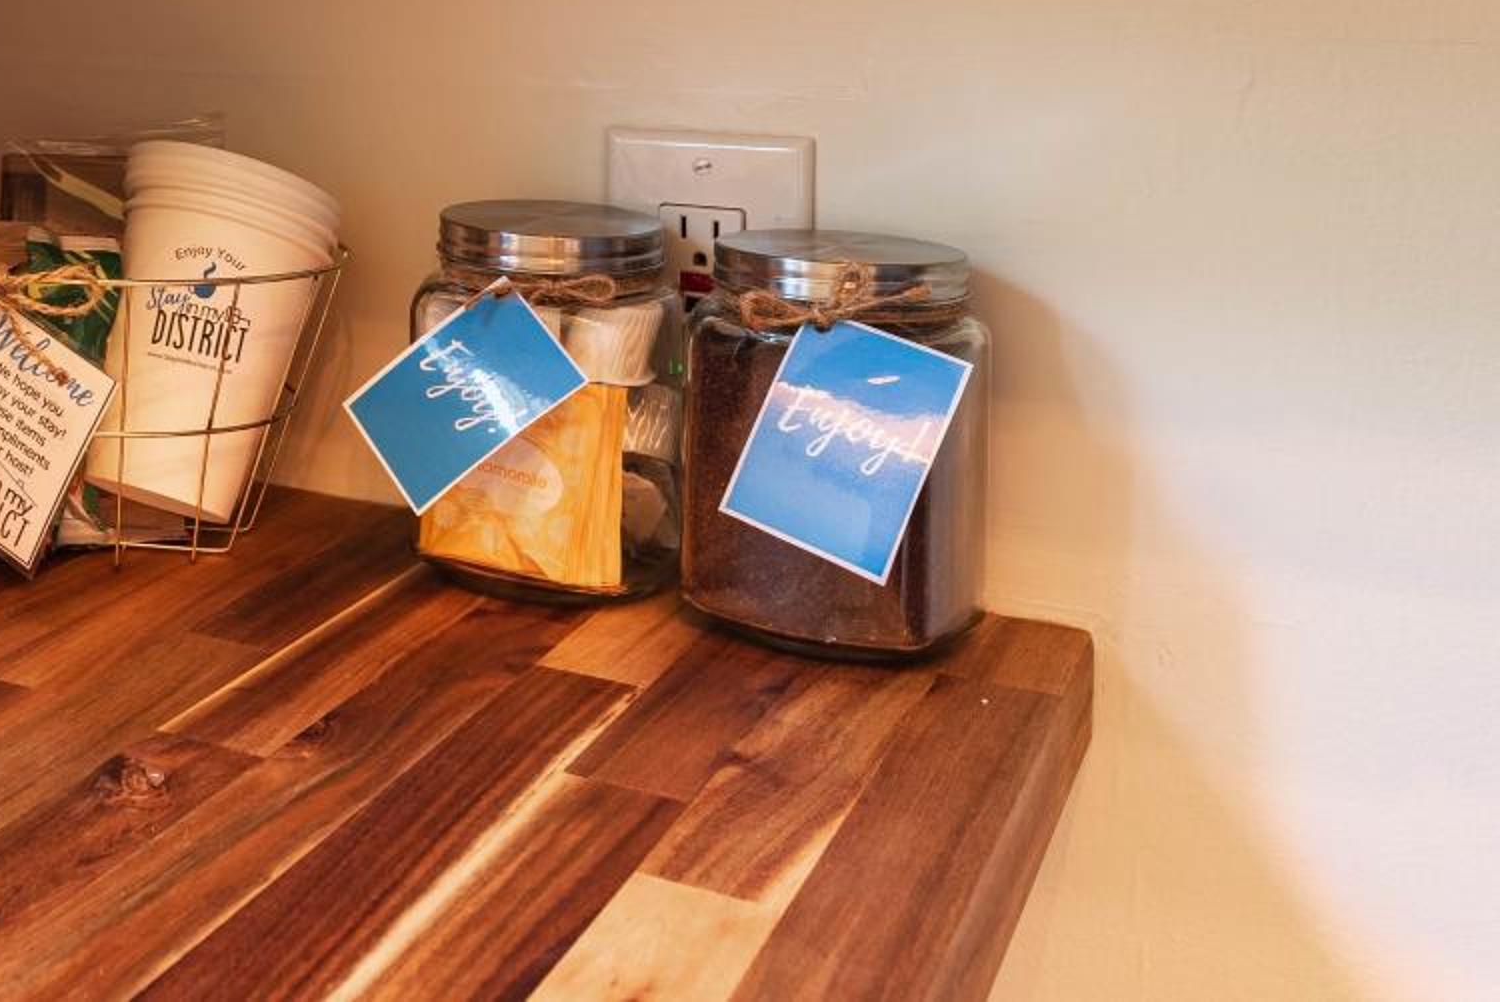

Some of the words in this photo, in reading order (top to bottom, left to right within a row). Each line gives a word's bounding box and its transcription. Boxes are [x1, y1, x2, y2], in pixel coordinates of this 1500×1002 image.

[175, 246, 213, 260] Enjoy
[217, 247, 246, 271] Your
[146, 286, 193, 314] Stay
[151, 309, 249, 363] DISTRICT
[12, 374, 41, 401] hope
[41, 397, 64, 417] you
[11, 397, 36, 417] your
[38, 415, 67, 438] stay!
[15, 419, 46, 446] items
[5, 450, 34, 475] host!
[4, 488, 33, 517] my
